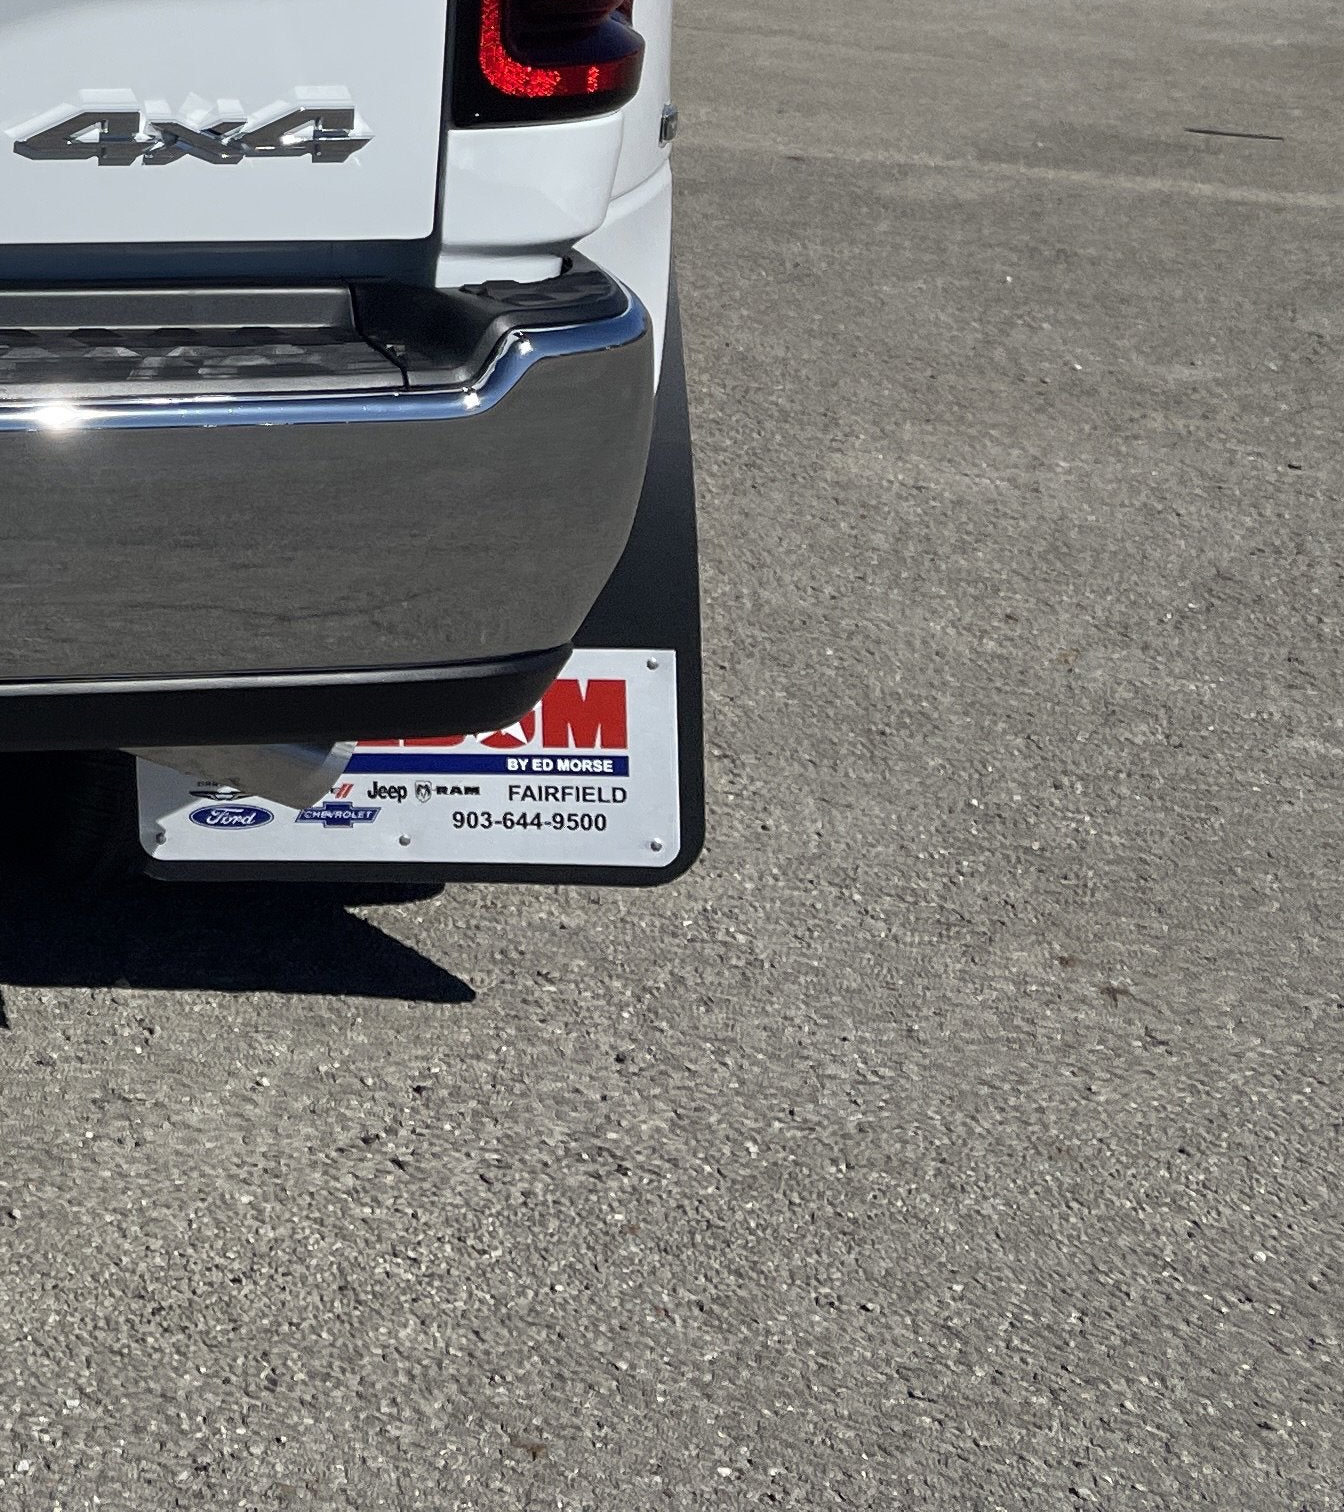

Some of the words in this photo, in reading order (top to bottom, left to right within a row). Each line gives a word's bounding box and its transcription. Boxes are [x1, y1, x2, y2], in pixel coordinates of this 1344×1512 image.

[12, 104, 375, 167] 4x4
[507, 758, 529, 771] BY
[532, 758, 554, 772] ED
[557, 759, 614, 773] MORSE
[367, 780, 408, 804] Jeep
[436, 785, 481, 796] RAM
[508, 784, 628, 804] FAIRFIELD
[205, 808, 257, 826] Ford
[303, 810, 373, 819] CHEVROLET
[452, 810, 607, 831] 903-644-9500
